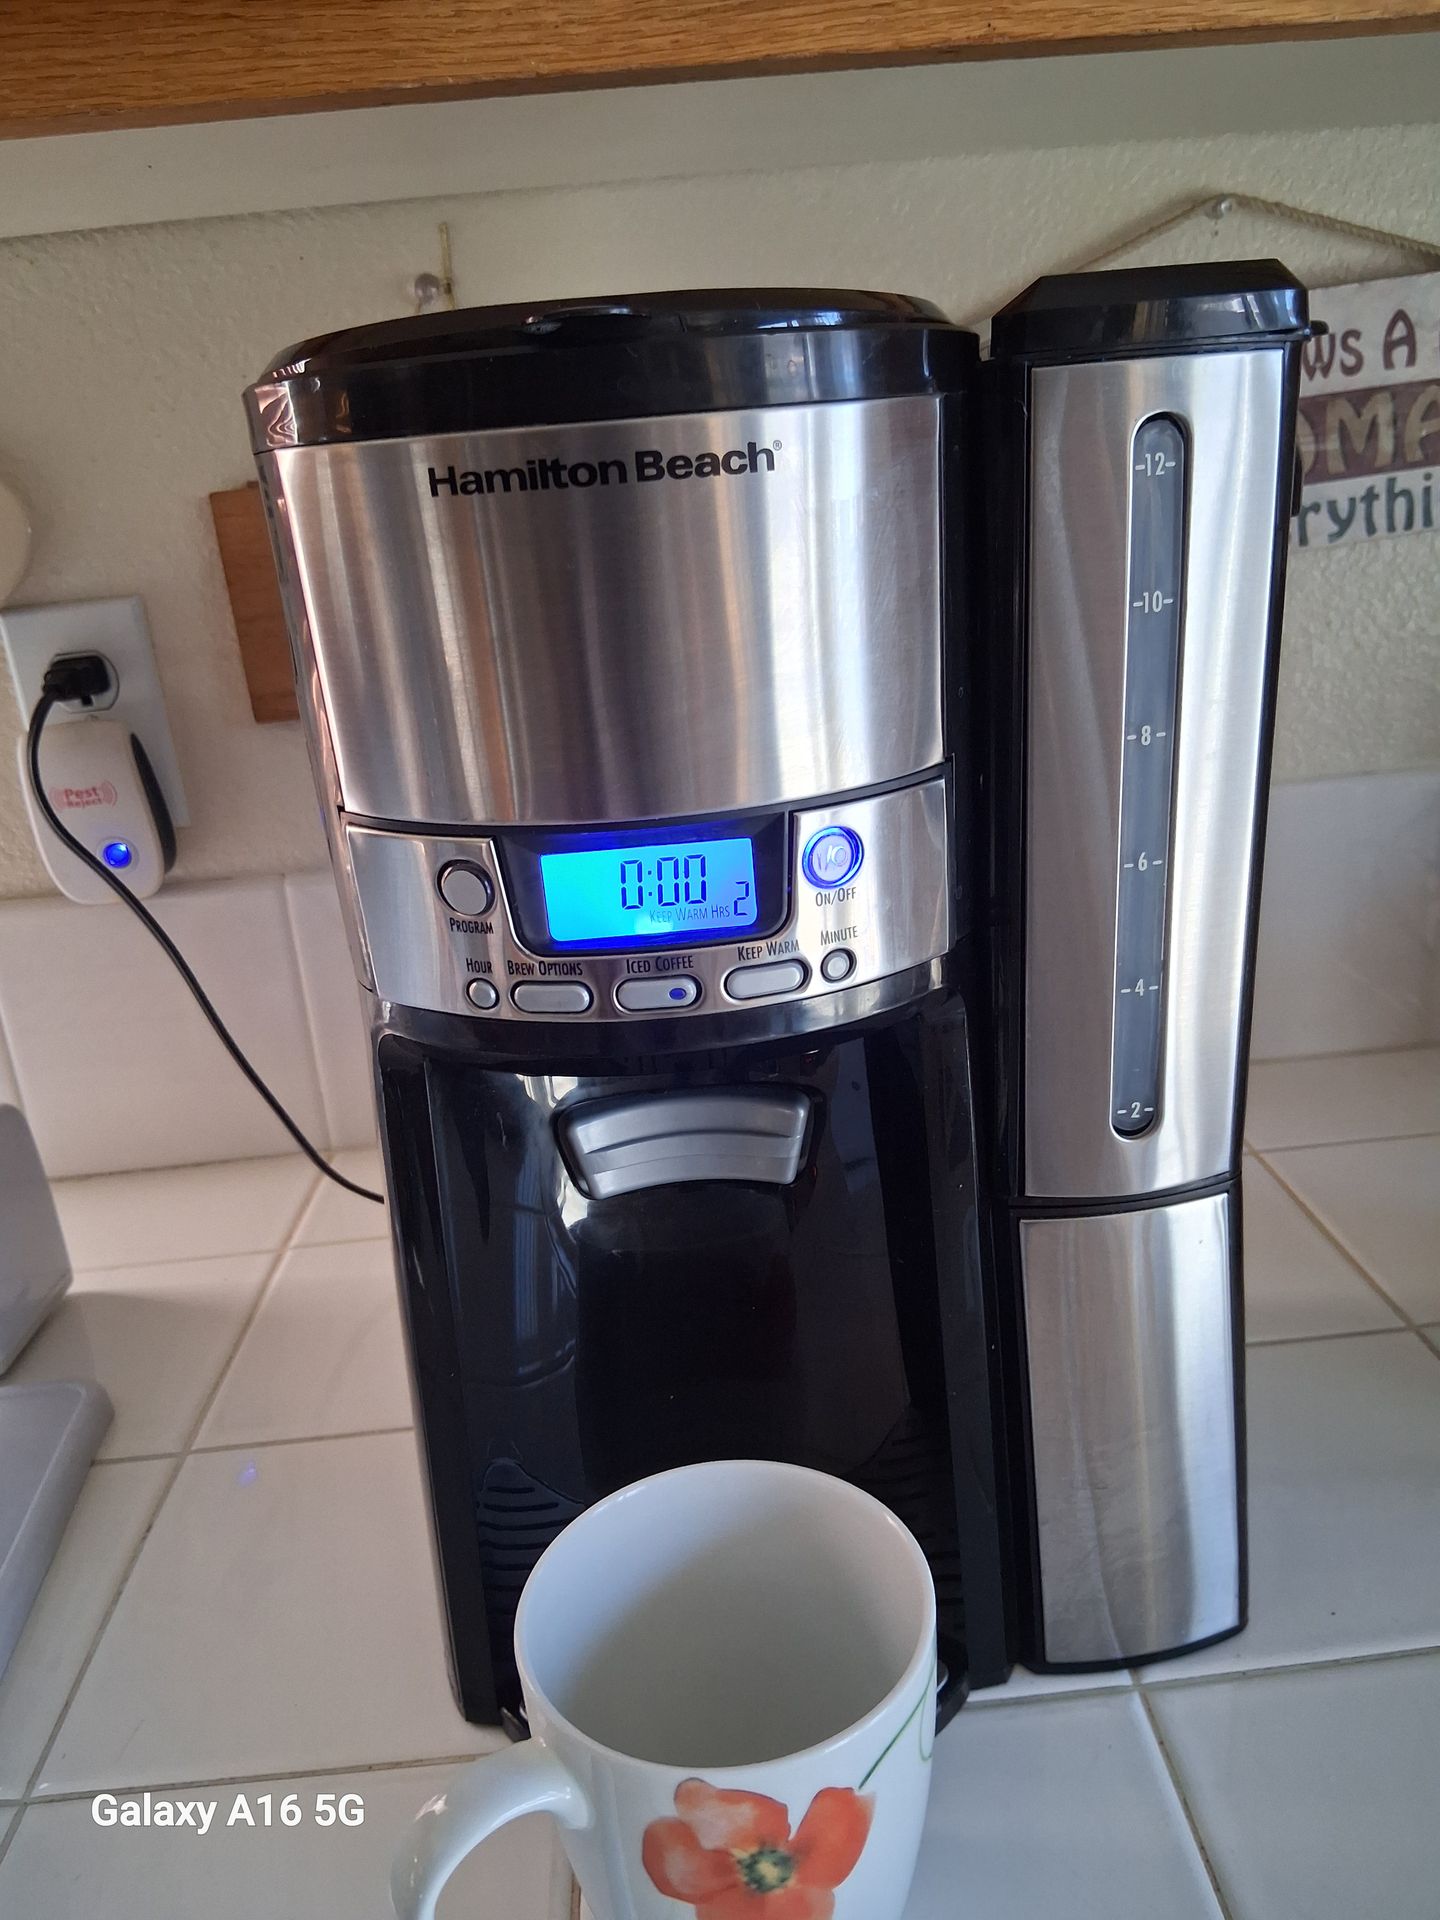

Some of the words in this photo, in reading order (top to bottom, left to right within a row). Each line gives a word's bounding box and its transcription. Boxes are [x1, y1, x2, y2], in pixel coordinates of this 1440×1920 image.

[1383, 309, 1416, 370] A
[428, 456, 628, 498] Hamilton
[64, 786, 99, 800] Pest
[620, 854, 708, 910] 0:00
[650, 907, 673, 924] KEEP
[675, 904, 709, 921] WARM
[711, 904, 731, 919] HRS
[733, 880, 750, 916] 2
[815, 886, 857, 907] ON/OFF
[449, 917, 494, 935] PROGRAM
[820, 926, 859, 947] MINUTE
[737, 945, 763, 962] KEEP
[766, 939, 800, 956] WARM
[466, 957, 493, 974] HOUR
[508, 959, 535, 976] BREW
[538, 960, 583, 977] OPTIONS
[626, 959, 651, 975] ICED
[655, 955, 695, 973] COFFEE
